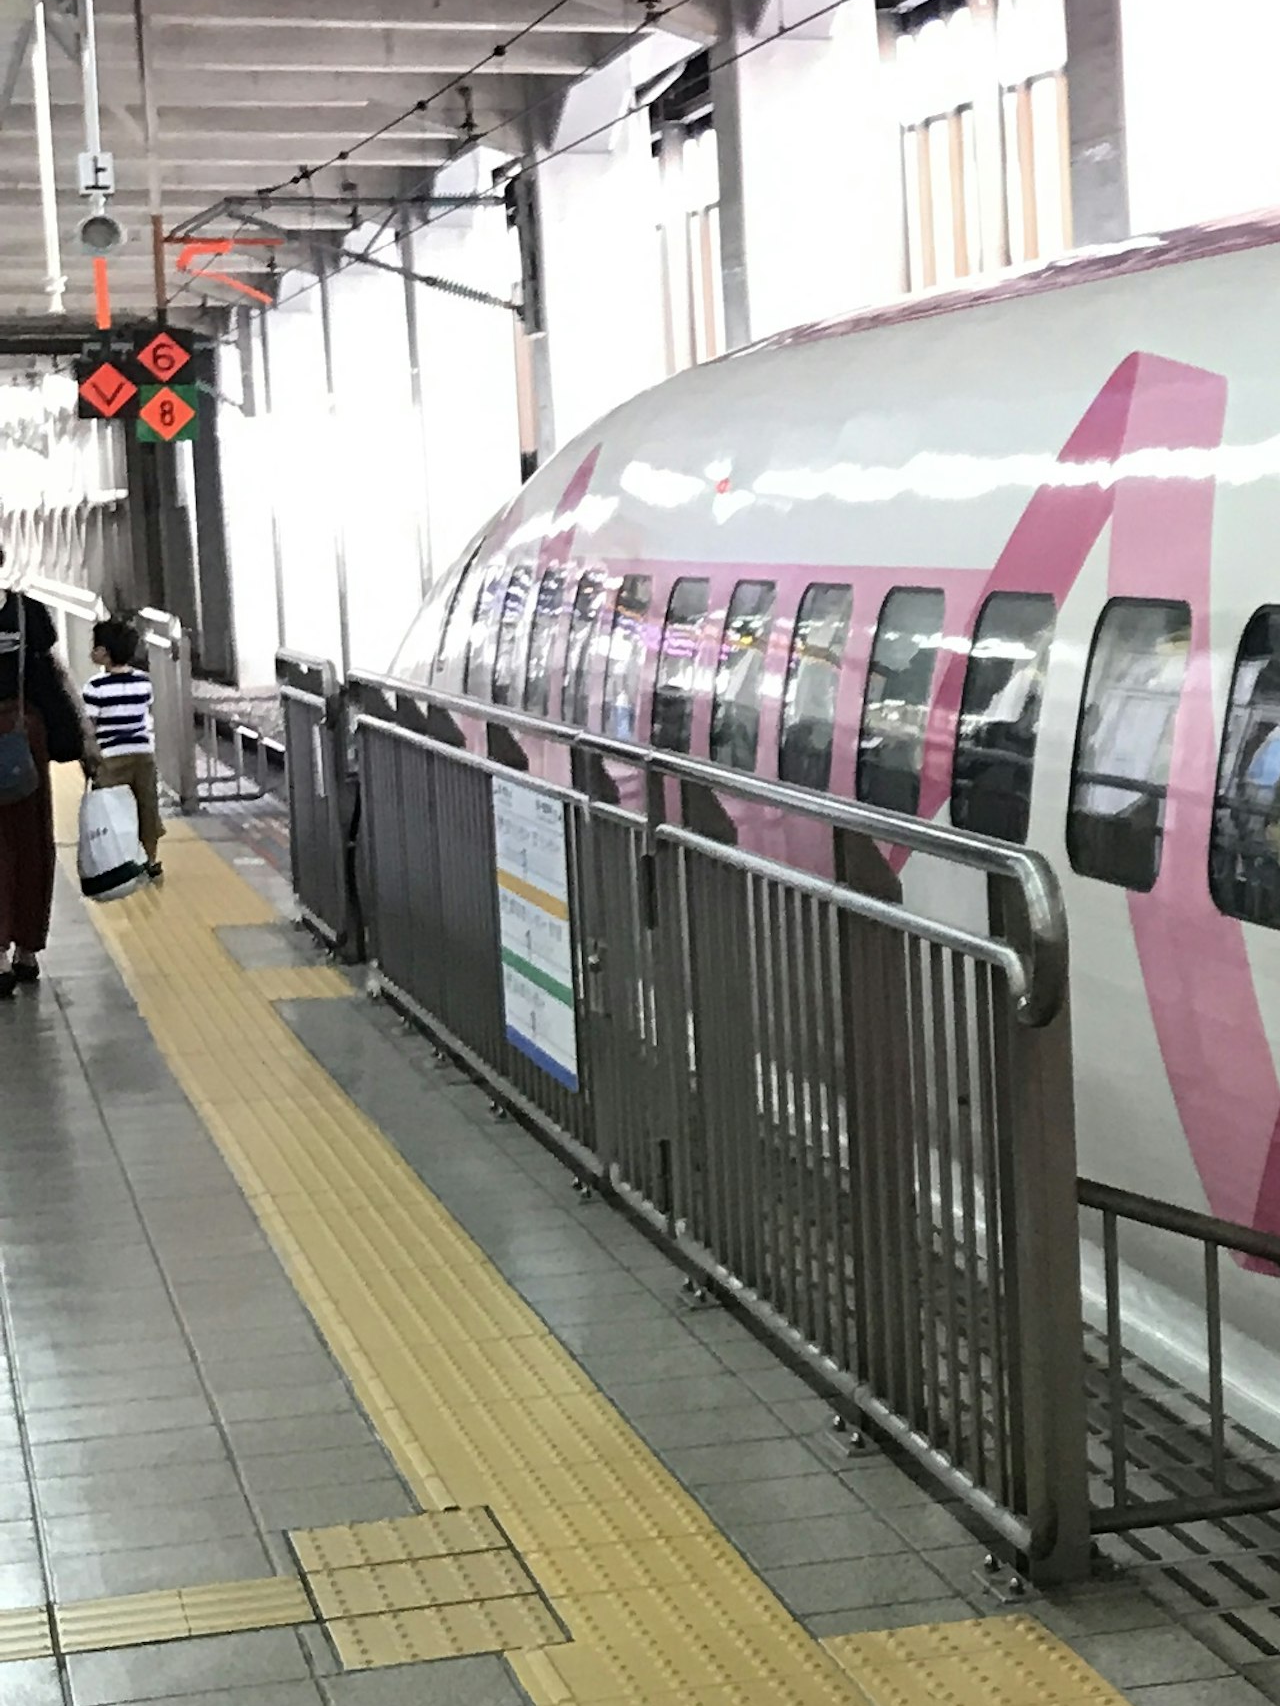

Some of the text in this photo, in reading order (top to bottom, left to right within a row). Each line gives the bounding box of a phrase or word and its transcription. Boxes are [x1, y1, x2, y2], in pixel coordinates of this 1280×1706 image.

[84, 155, 111, 190] 上
[152, 343, 175, 371] 6
[159, 399, 176, 426] 8
